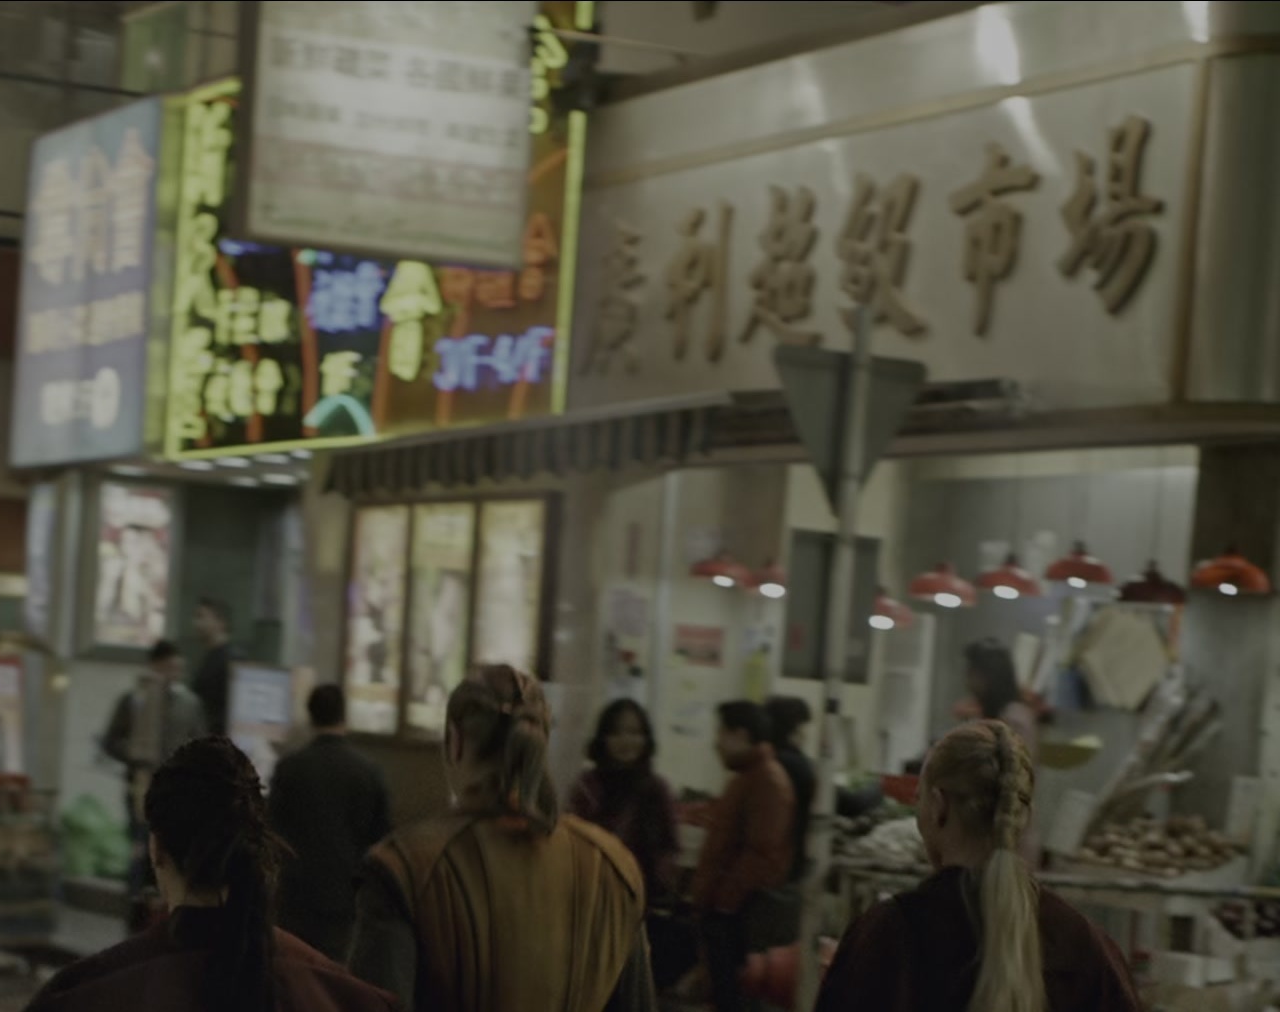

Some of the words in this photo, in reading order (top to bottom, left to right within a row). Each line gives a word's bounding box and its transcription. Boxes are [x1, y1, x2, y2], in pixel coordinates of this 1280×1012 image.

[578, 112, 1164, 377] 廣利超級市場
